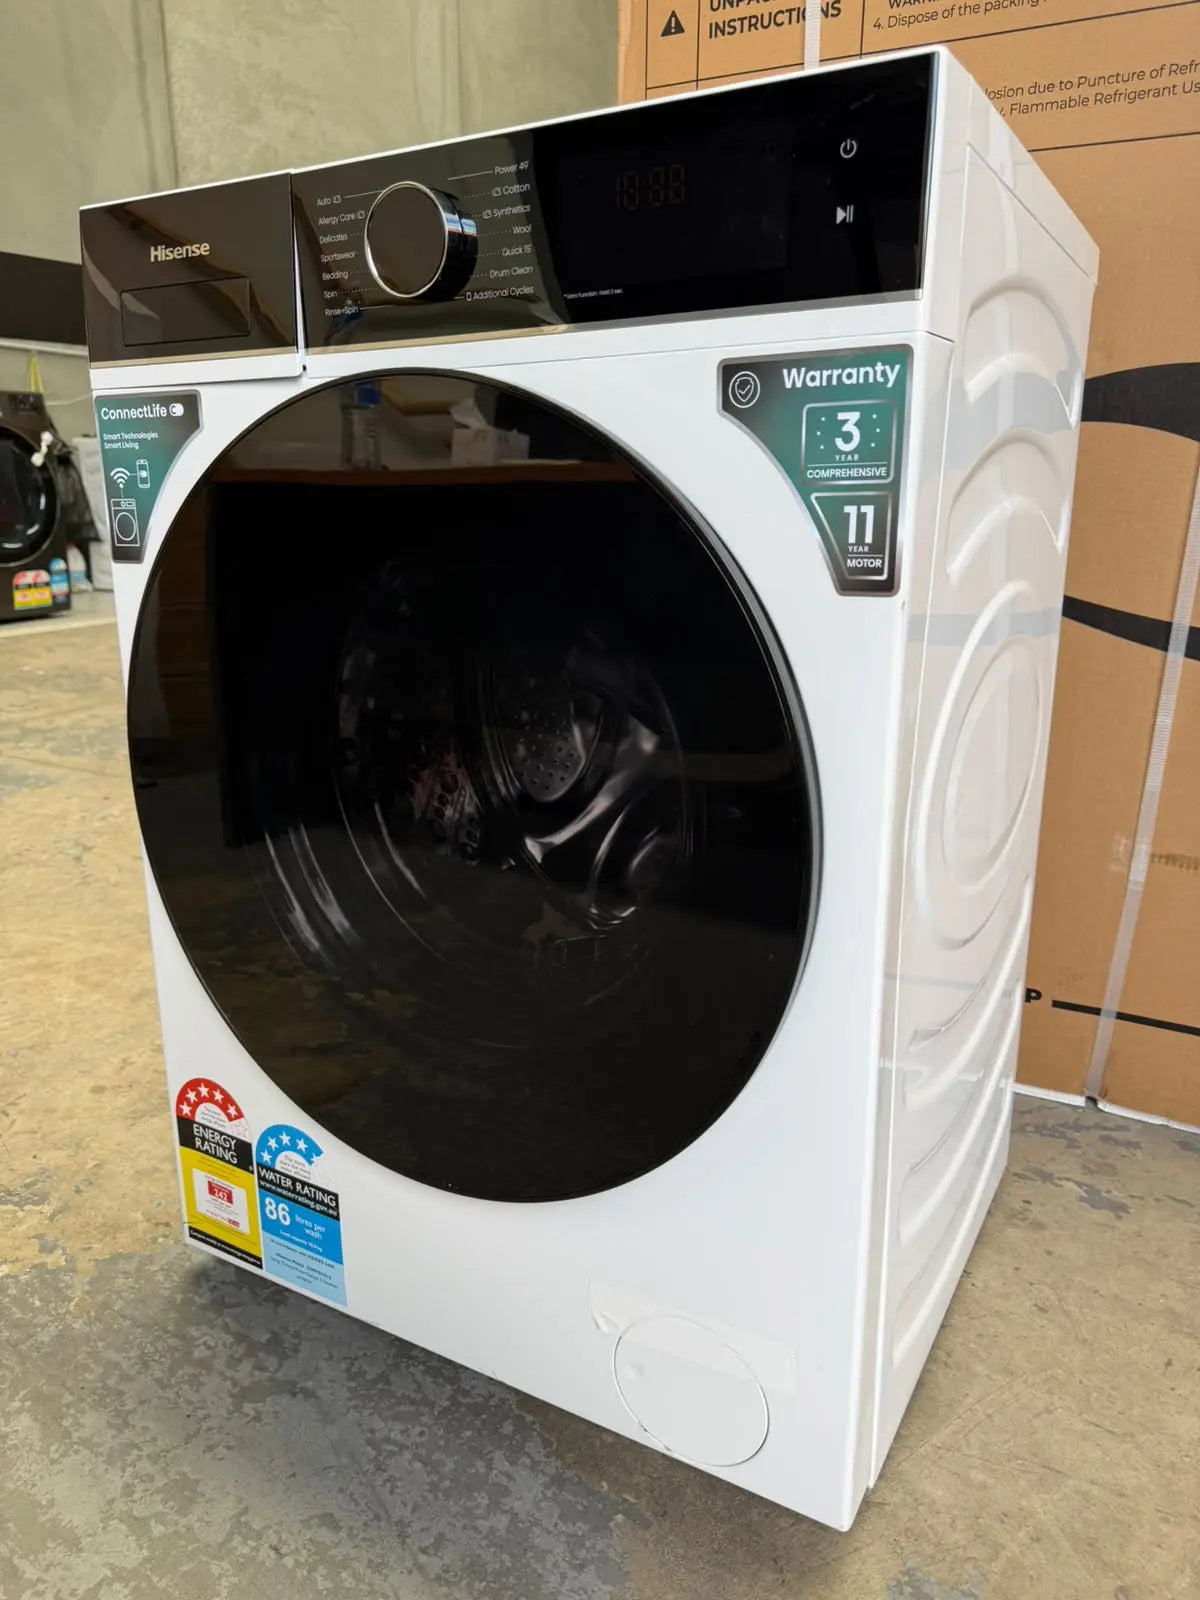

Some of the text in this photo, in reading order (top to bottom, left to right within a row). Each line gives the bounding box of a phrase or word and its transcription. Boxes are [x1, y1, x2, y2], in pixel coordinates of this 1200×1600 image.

[708, 1, 842, 39] INSTRUCTINS
[873, 18, 884, 30] 4.
[887, 11, 939, 28] Dispose
[942, 4, 956, 19] of
[958, 2, 981, 17] the
[1027, 81, 1056, 95] due
[1059, 79, 1074, 91] to
[1077, 69, 1146, 88] Puncture
[1150, 64, 1167, 79] of
[1010, 95, 1090, 116] Flammable
[1094, 83, 1178, 105] Refrigerant
[494, 164, 518, 176] Power
[502, 183, 531, 195] Cotton
[316, 198, 332, 206] Auto
[493, 204, 531, 218] Synthetics
[318, 213, 356, 226] Allergy Care
[512, 227, 532, 235] Wool
[320, 233, 348, 244] Delicates
[150, 242, 210, 262] Hisense
[320, 251, 356, 264] Sportswear
[502, 246, 523, 257] Quick
[322, 270, 349, 281] Bedding
[489, 266, 533, 279] Drum Clean
[324, 290, 338, 299] Spin
[473, 285, 535, 300] Additional Cycles
[325, 305, 359, 317] Rinse+Spin
[782, 362, 901, 389] Warranty
[101, 403, 168, 420] ConnectLife
[103, 431, 159, 441] Smart Technologies
[834, 411, 861, 452] 3
[104, 440, 139, 450] Smart Living
[834, 454, 860, 462] YEAR
[806, 466, 888, 479] COMPREHENSIVE
[843, 504, 875, 544] 11
[848, 545, 870, 553] YEAR
[846, 558, 883, 568] MOTOR
[193, 1123, 237, 1151] ENERGY
[195, 1137, 238, 1165] RATING
[258, 1165, 293, 1190] WATER
[295, 1181, 337, 1208] RATING
[259, 1180, 338, 1217] www.waterrating.gov.au
[264, 1196, 291, 1227] 86
[295, 1213, 326, 1233] litres per
[304, 1227, 322, 1240] wash
